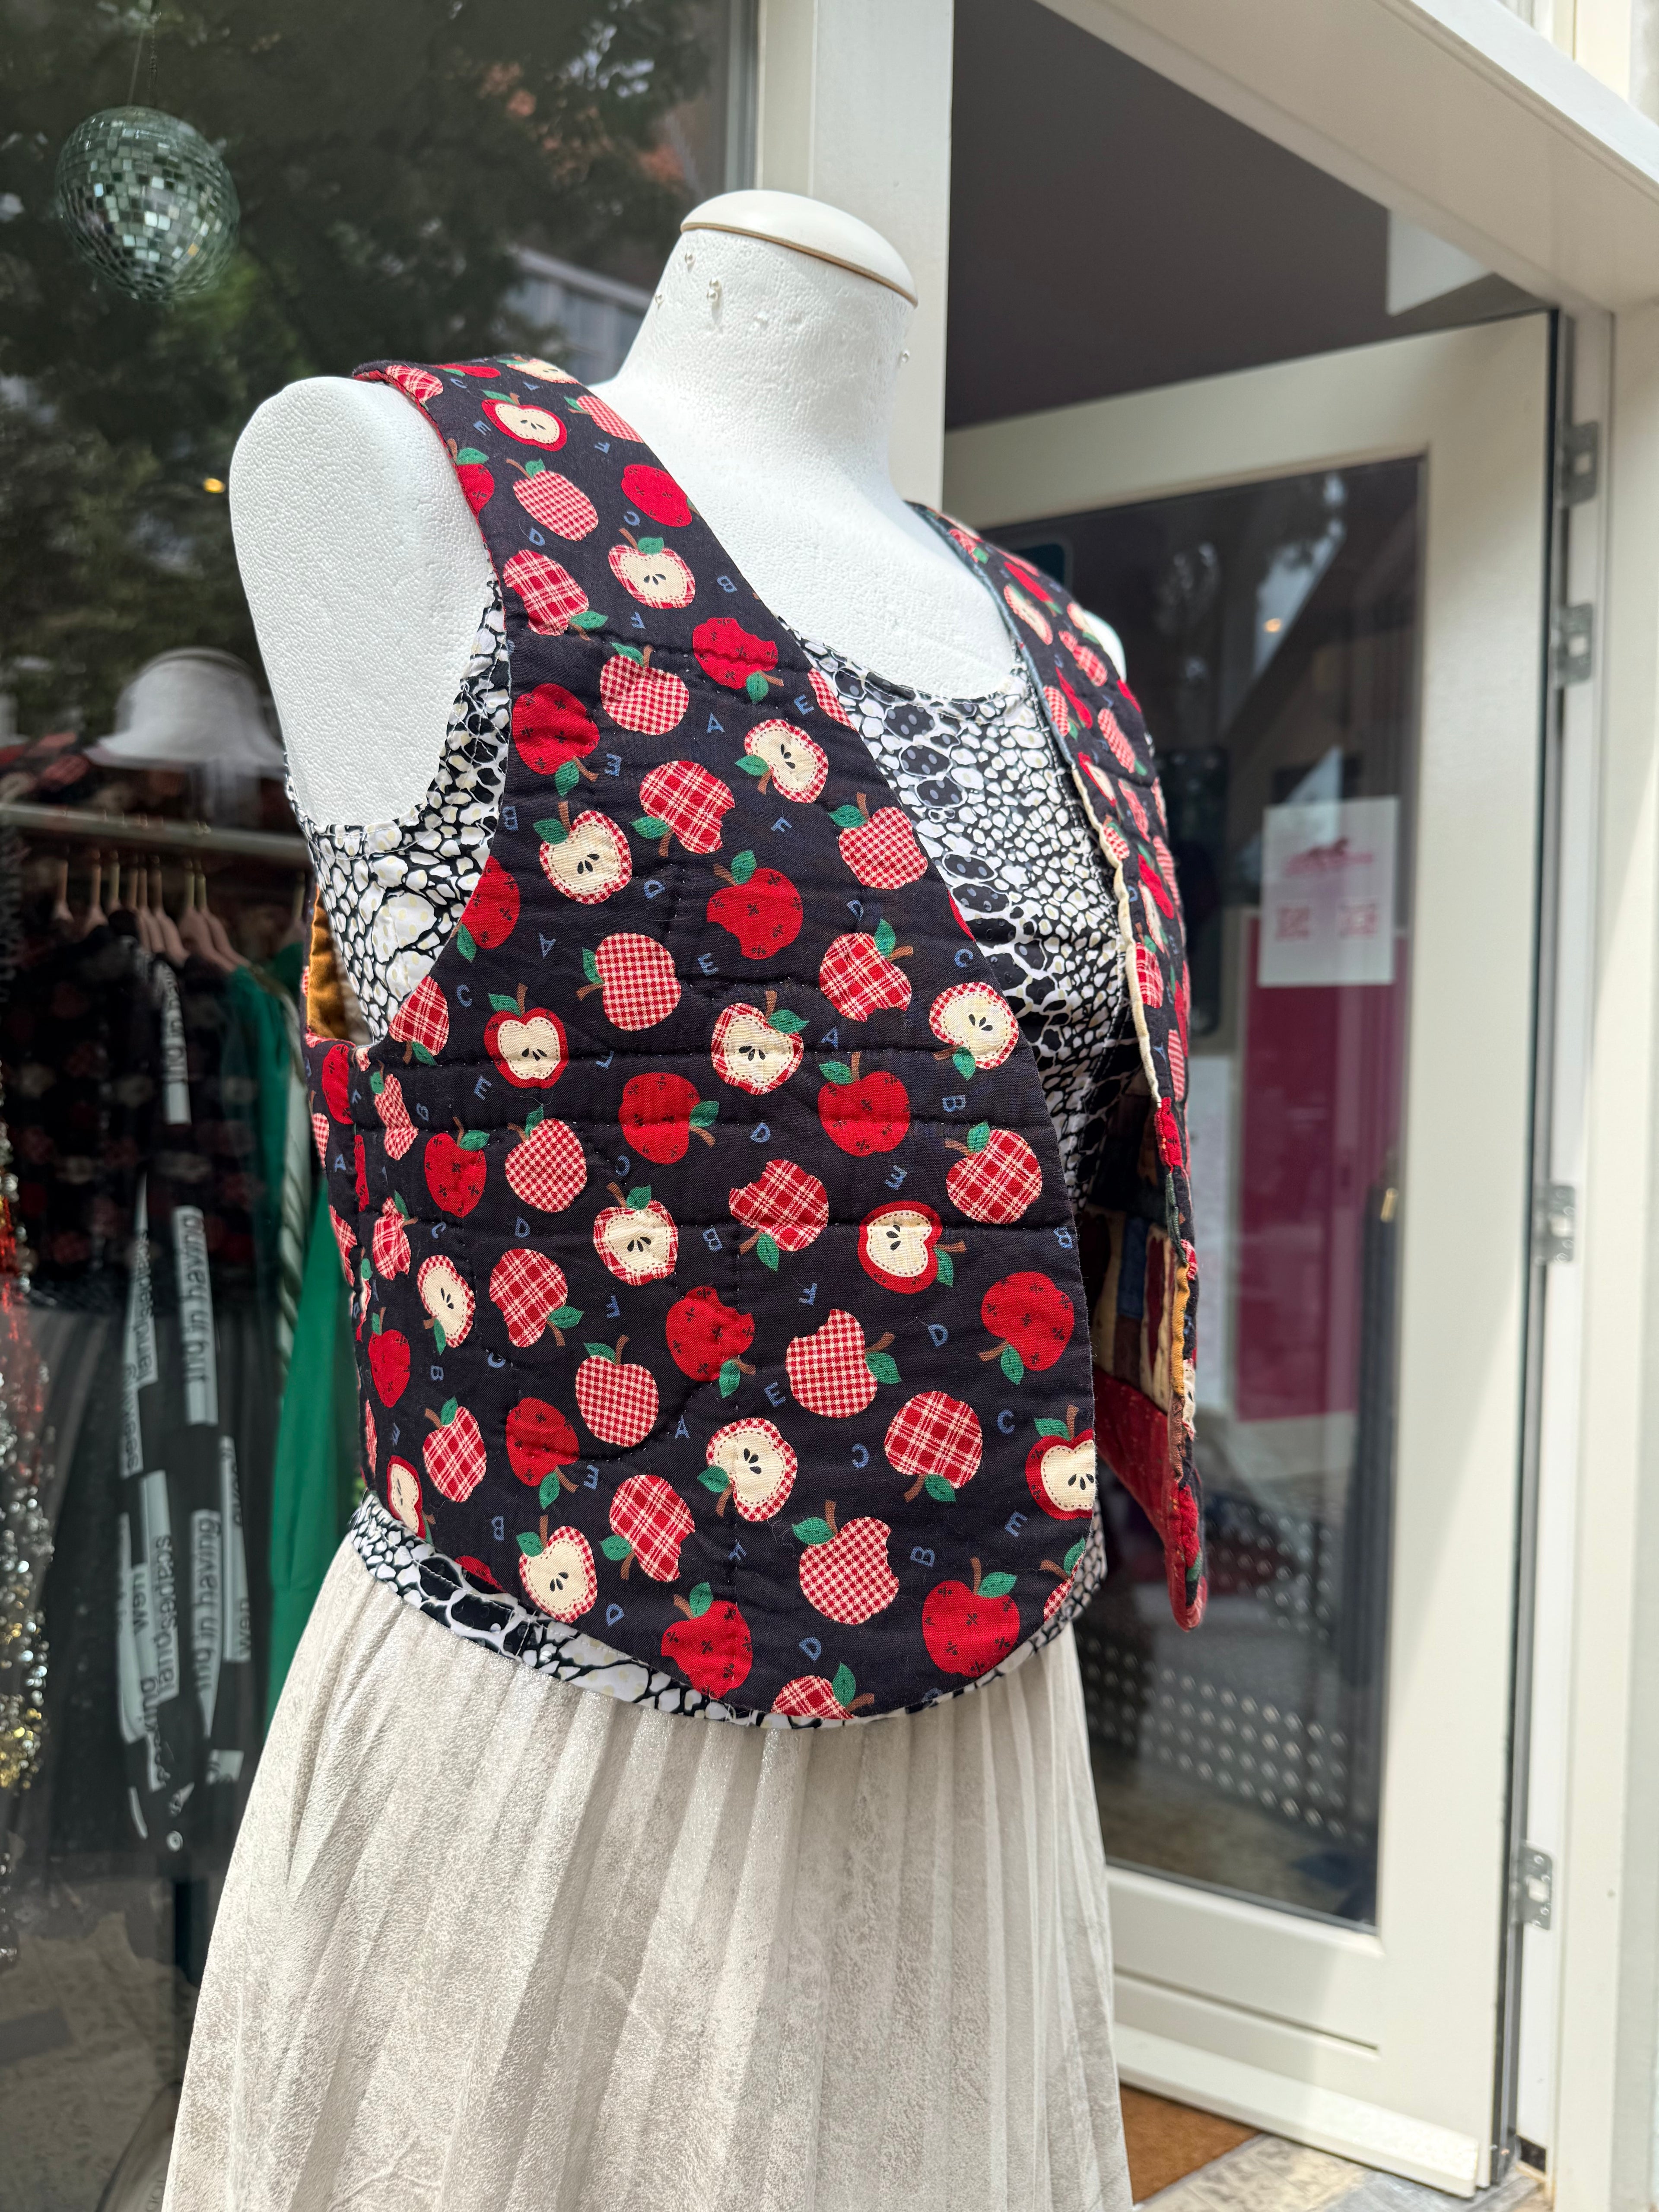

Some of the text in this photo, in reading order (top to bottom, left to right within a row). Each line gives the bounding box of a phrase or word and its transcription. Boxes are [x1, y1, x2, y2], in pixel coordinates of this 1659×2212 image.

[473, 420, 492, 435] E
[623, 510, 640, 527] C
[528, 527, 546, 547] D
[717, 575, 737, 594] B
[794, 694, 814, 716] E
[706, 712, 725, 737] A
[604, 753, 622, 777] E
[502, 806, 518, 831] B
[771, 817, 792, 832] F
[643, 880, 665, 900] D
[540, 934, 556, 957] A
[698, 954, 718, 975] E
[954, 949, 974, 969] C
[457, 985, 472, 1008] C
[820, 1027, 839, 1049] A
[474, 1076, 492, 1100] E
[942, 1096, 966, 1113] B
[751, 1123, 771, 1143] D
[334, 1154, 346, 1172] A
[885, 1167, 906, 1190] E
[431, 1222, 447, 1239] C
[515, 1217, 530, 1239] D
[1054, 1227, 1074, 1249] B
[703, 1228, 723, 1252] B
[799, 1283, 817, 1306] F
[928, 1324, 949, 1348] D
[431, 1366, 444, 1380] B
[765, 1383, 785, 1406] E
[675, 1415, 690, 1439] A
[997, 1410, 1015, 1434] C
[852, 1444, 870, 1469] C
[584, 1465, 599, 1491] E
[491, 1516, 505, 1542] B
[1005, 1512, 1027, 1537] E
[910, 1547, 935, 1567] B
[606, 1604, 624, 1627] D
[799, 1637, 822, 1661] D
